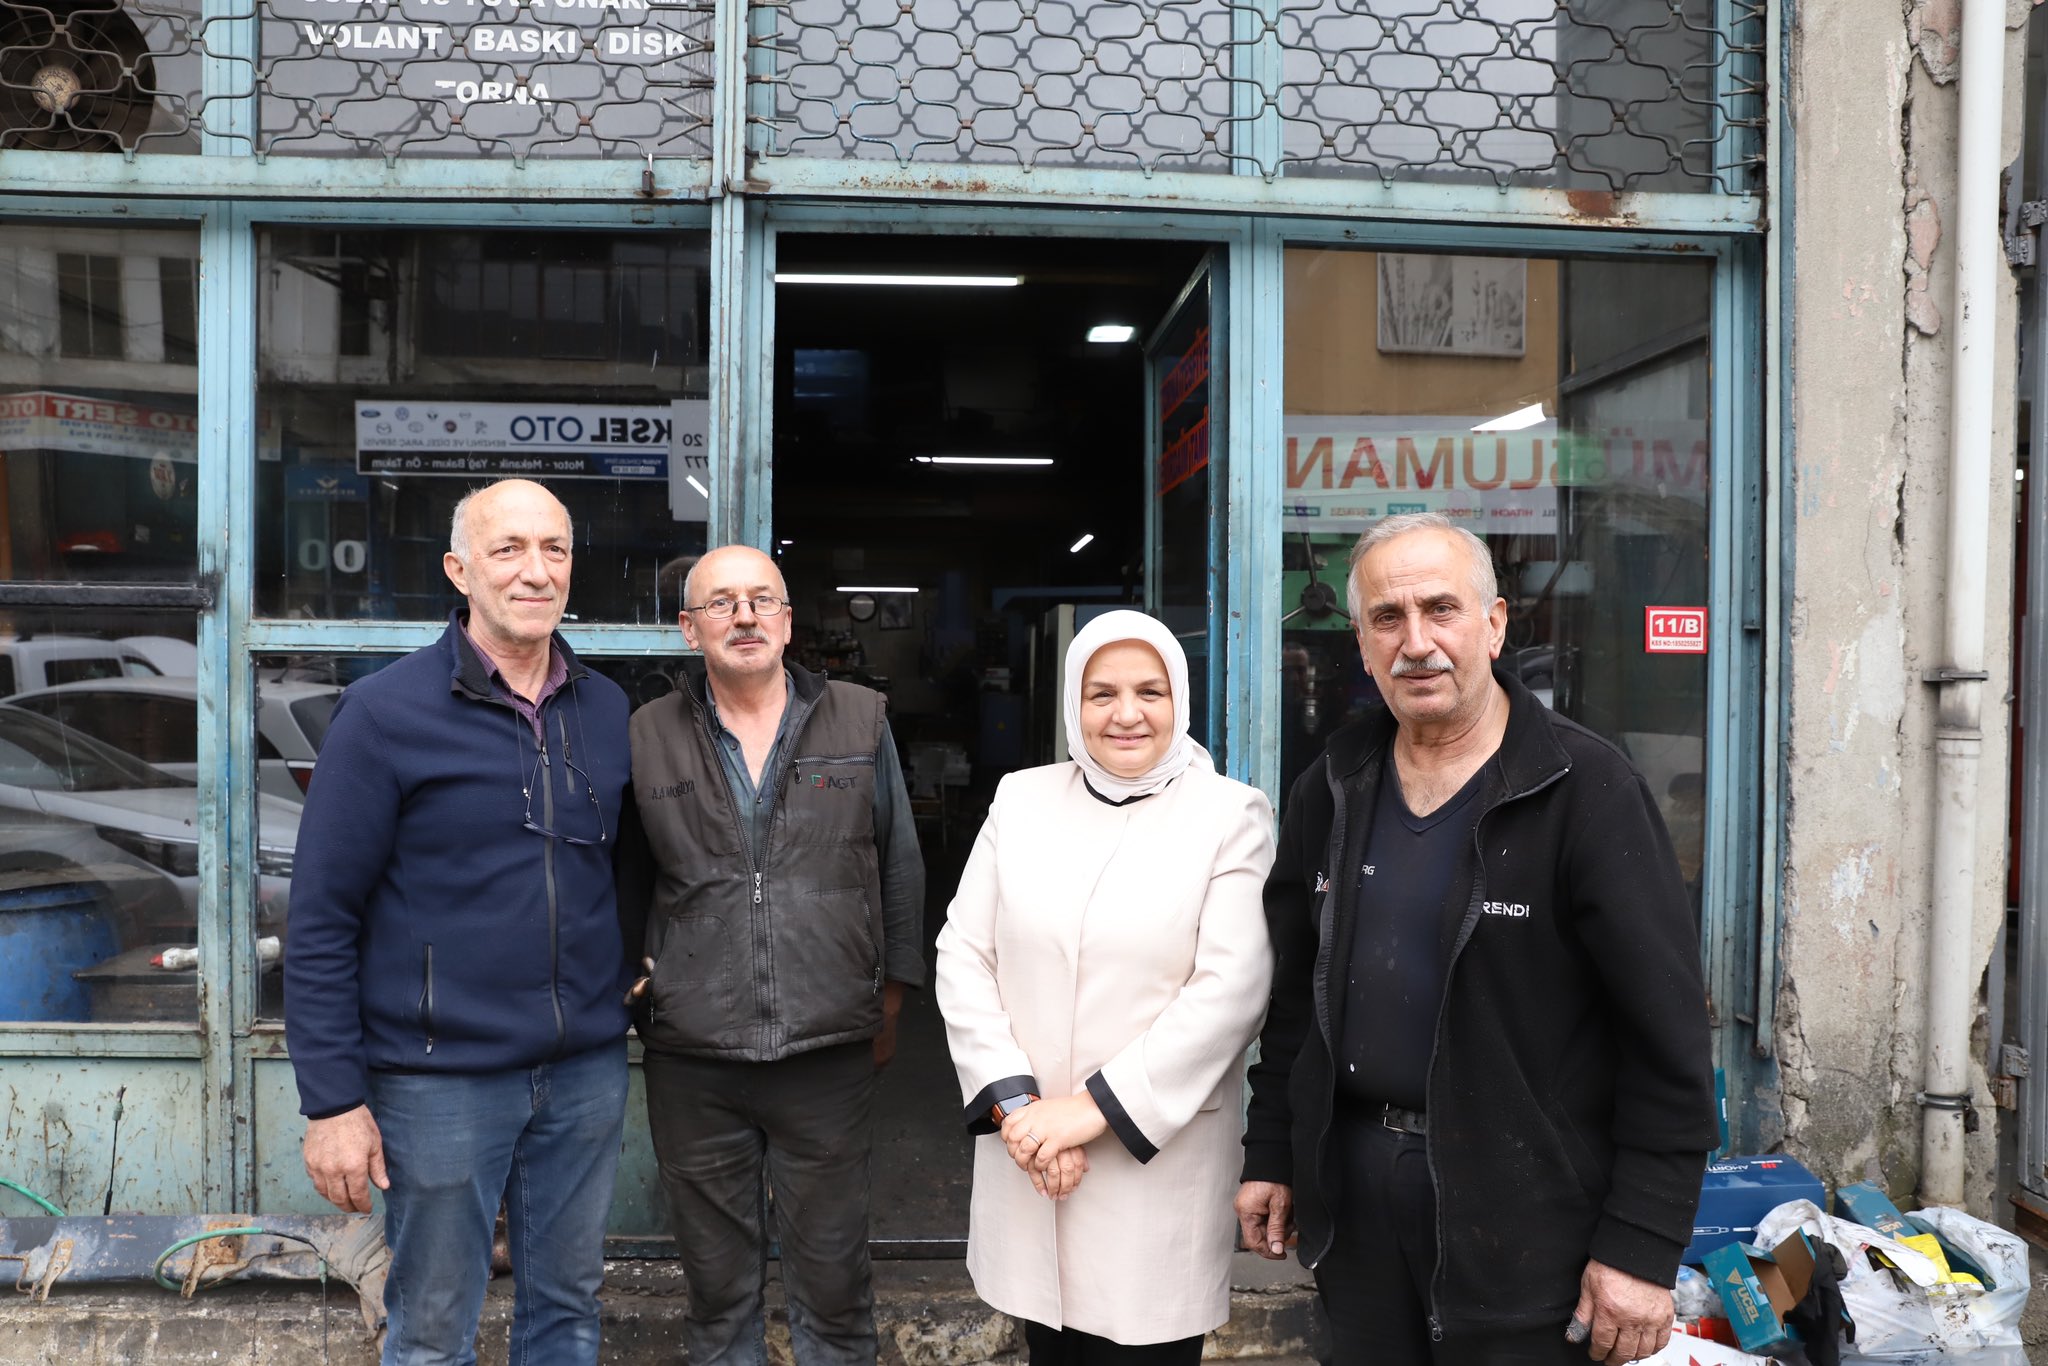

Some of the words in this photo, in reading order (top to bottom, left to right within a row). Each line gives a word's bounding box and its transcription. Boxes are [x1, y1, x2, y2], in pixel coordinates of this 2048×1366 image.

[304, 24, 442, 50] VOLANT
[474, 28, 576, 54] BASKI
[609, 26, 687, 55] DİSK
[1655, 618, 1699, 634] 11/B
[827, 775, 858, 790] AGT
